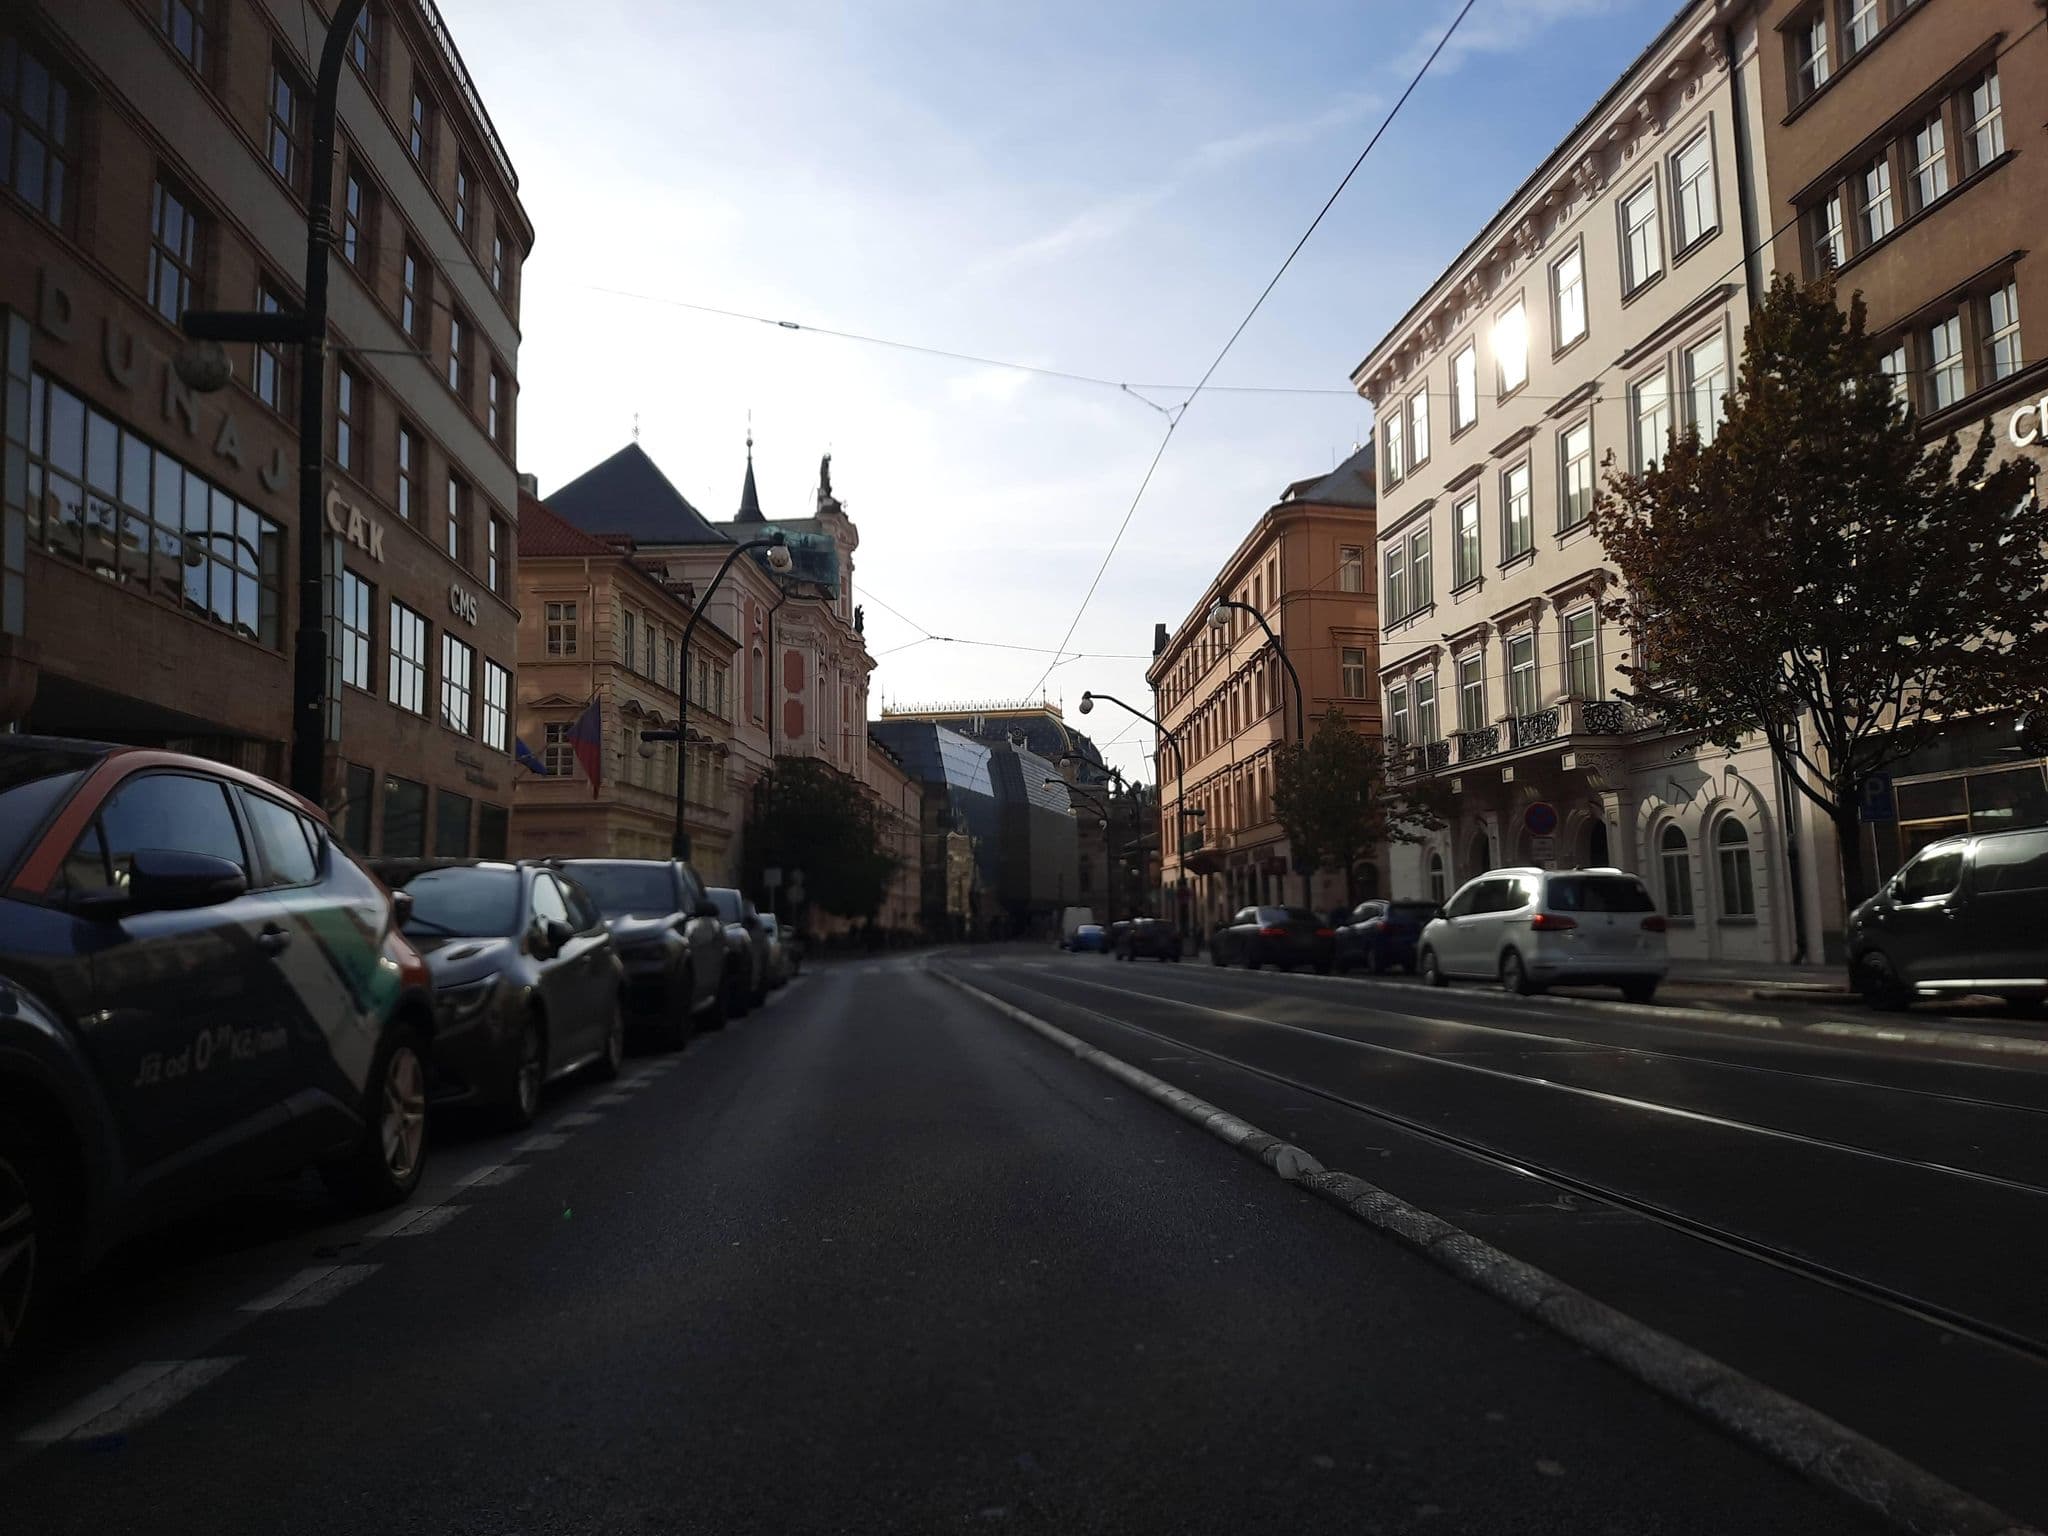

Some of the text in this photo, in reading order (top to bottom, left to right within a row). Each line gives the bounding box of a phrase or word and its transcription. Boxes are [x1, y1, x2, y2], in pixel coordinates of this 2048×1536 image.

[38, 262, 290, 494] DUNAJ
[326, 479, 384, 564] ČAK
[450, 583, 478, 627] CMS
[1865, 777, 1884, 805] P
